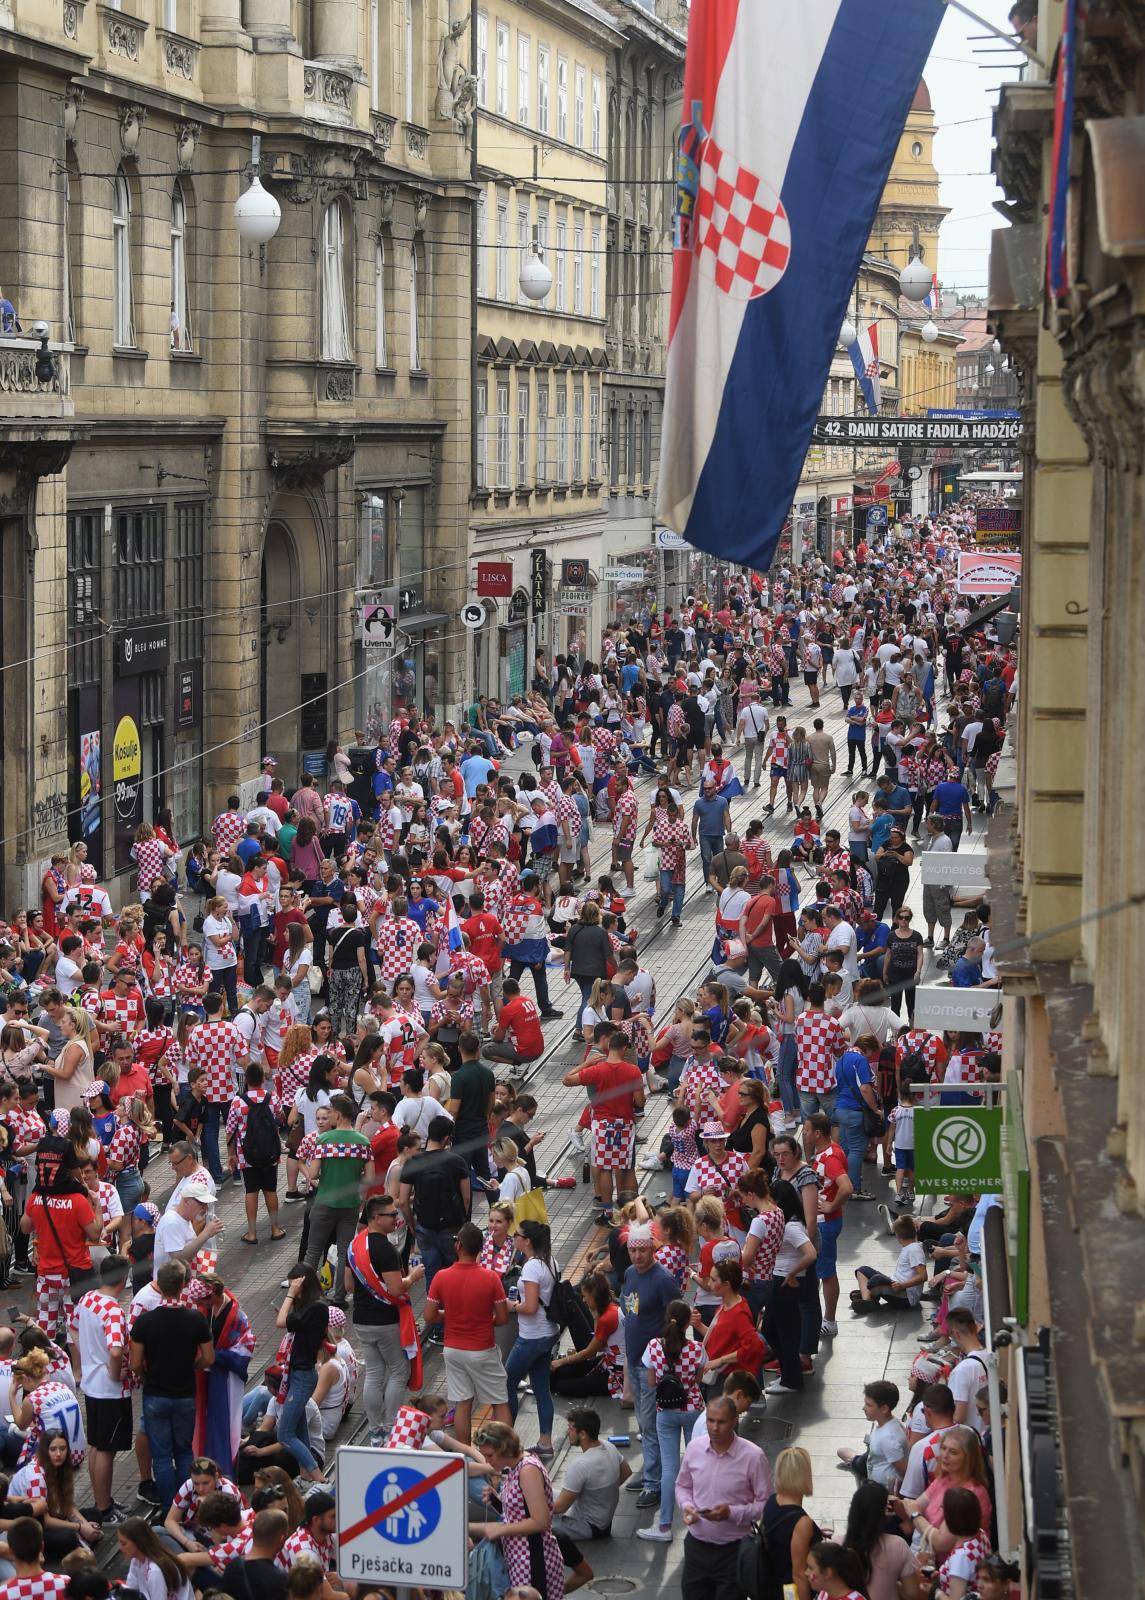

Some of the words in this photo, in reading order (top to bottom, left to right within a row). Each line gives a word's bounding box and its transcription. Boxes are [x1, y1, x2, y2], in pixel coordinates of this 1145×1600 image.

[824, 422, 845, 436] 42.
[848, 423, 878, 436] DANI
[881, 424, 924, 438] SATIRE
[927, 424, 970, 438] FADILA
[482, 574, 507, 582] LISCA
[605, 569, 618, 578] naš
[626, 569, 642, 578] dom
[135, 643, 146, 652] BLEU
[522, 1000, 534, 1012] 10
[38, 1162, 60, 1187] 17
[919, 1178, 948, 1187] YVES
[952, 1178, 1002, 1186] ROCHER
[34, 1196, 72, 1210] HRATSKA
[53, 1404, 79, 1442] 17
[352, 1554, 412, 1574] Pješačka
[420, 1562, 452, 1577] zona
